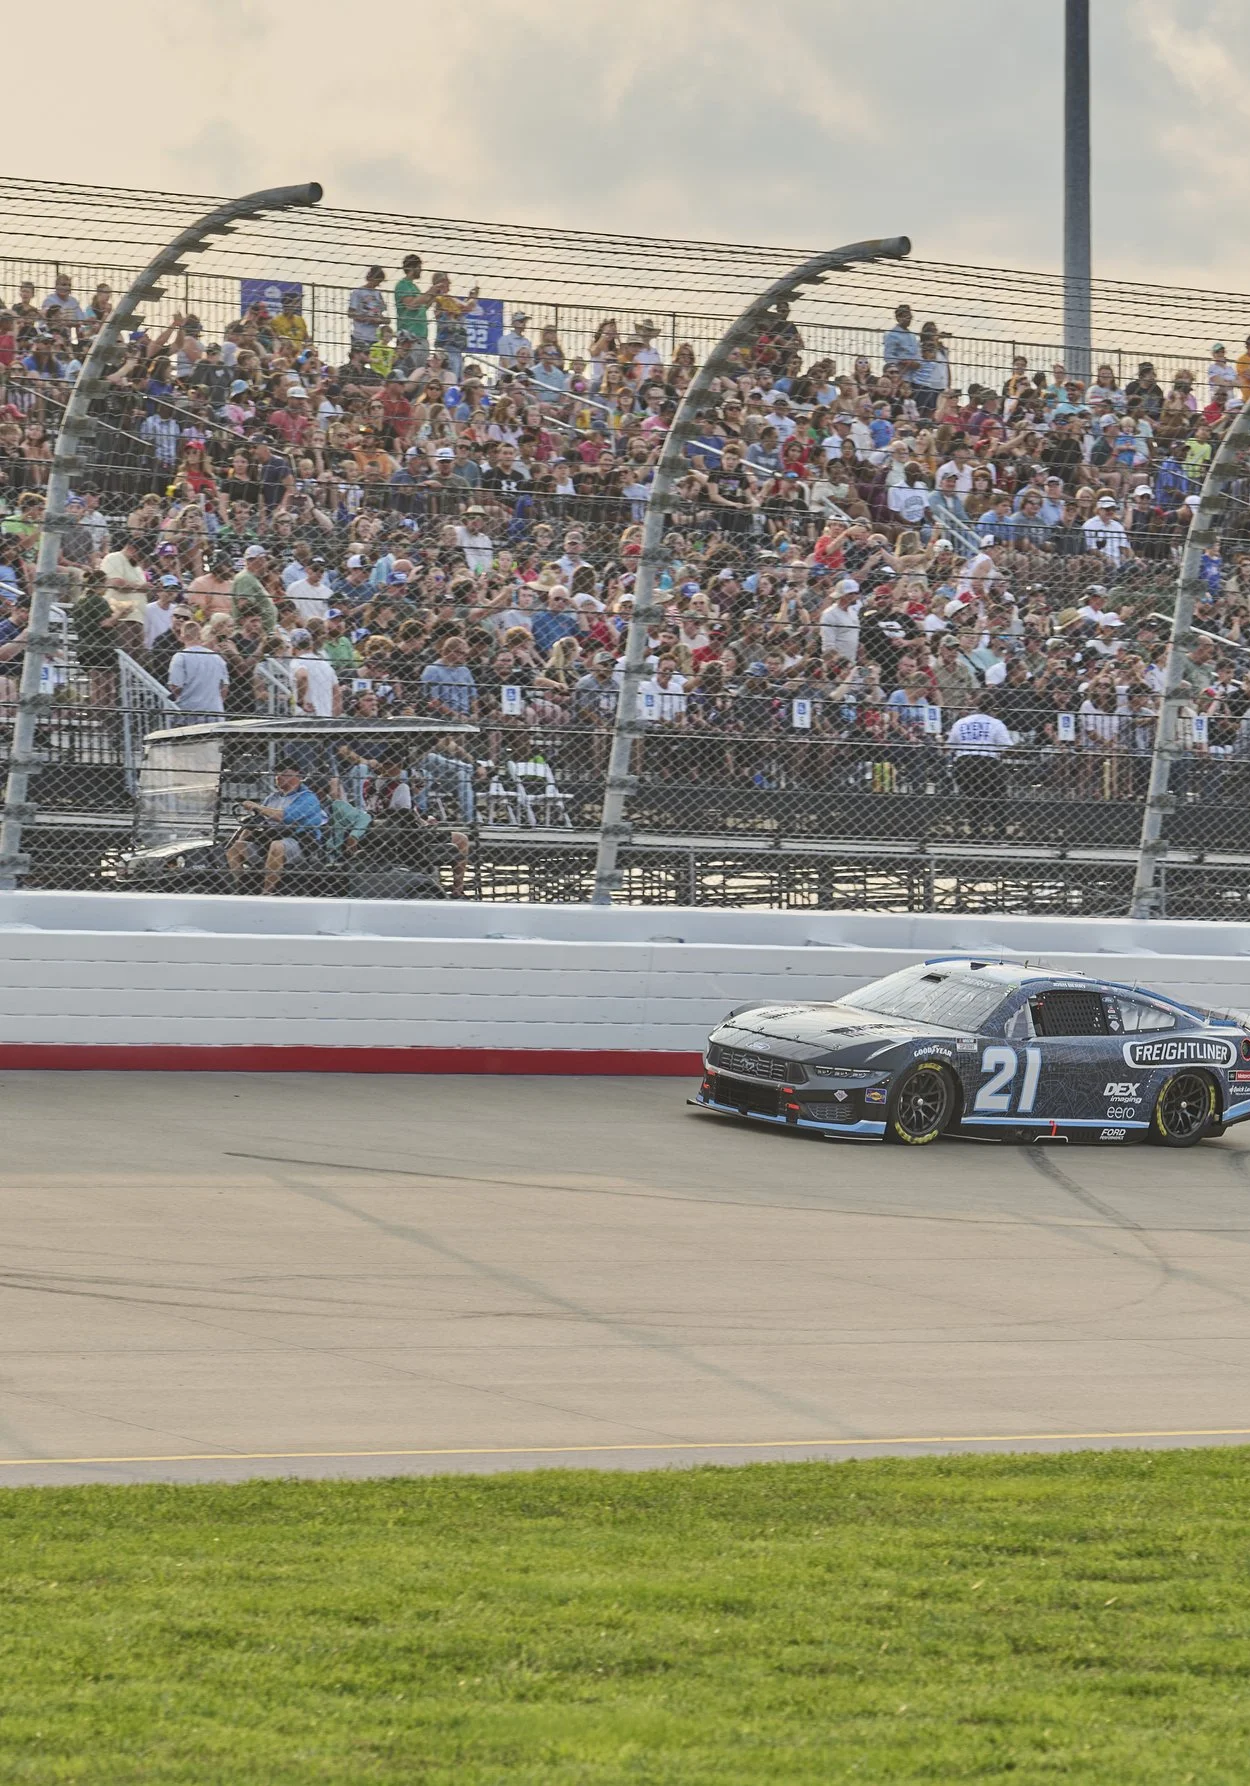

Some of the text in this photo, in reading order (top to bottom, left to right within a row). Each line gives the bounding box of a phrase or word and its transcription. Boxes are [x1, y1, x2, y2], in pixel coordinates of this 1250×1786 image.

[962, 976, 998, 989] BERRY
[913, 1044, 953, 1058] GOODYEAR
[1135, 1042, 1229, 1062] FREIGHTLINER
[973, 1045, 1042, 1113] 21
[1103, 1082, 1141, 1096] DEX
[1110, 1095, 1142, 1104] imaging
[1106, 1106, 1135, 1119] eero
[1101, 1128, 1126, 1136] FORD
